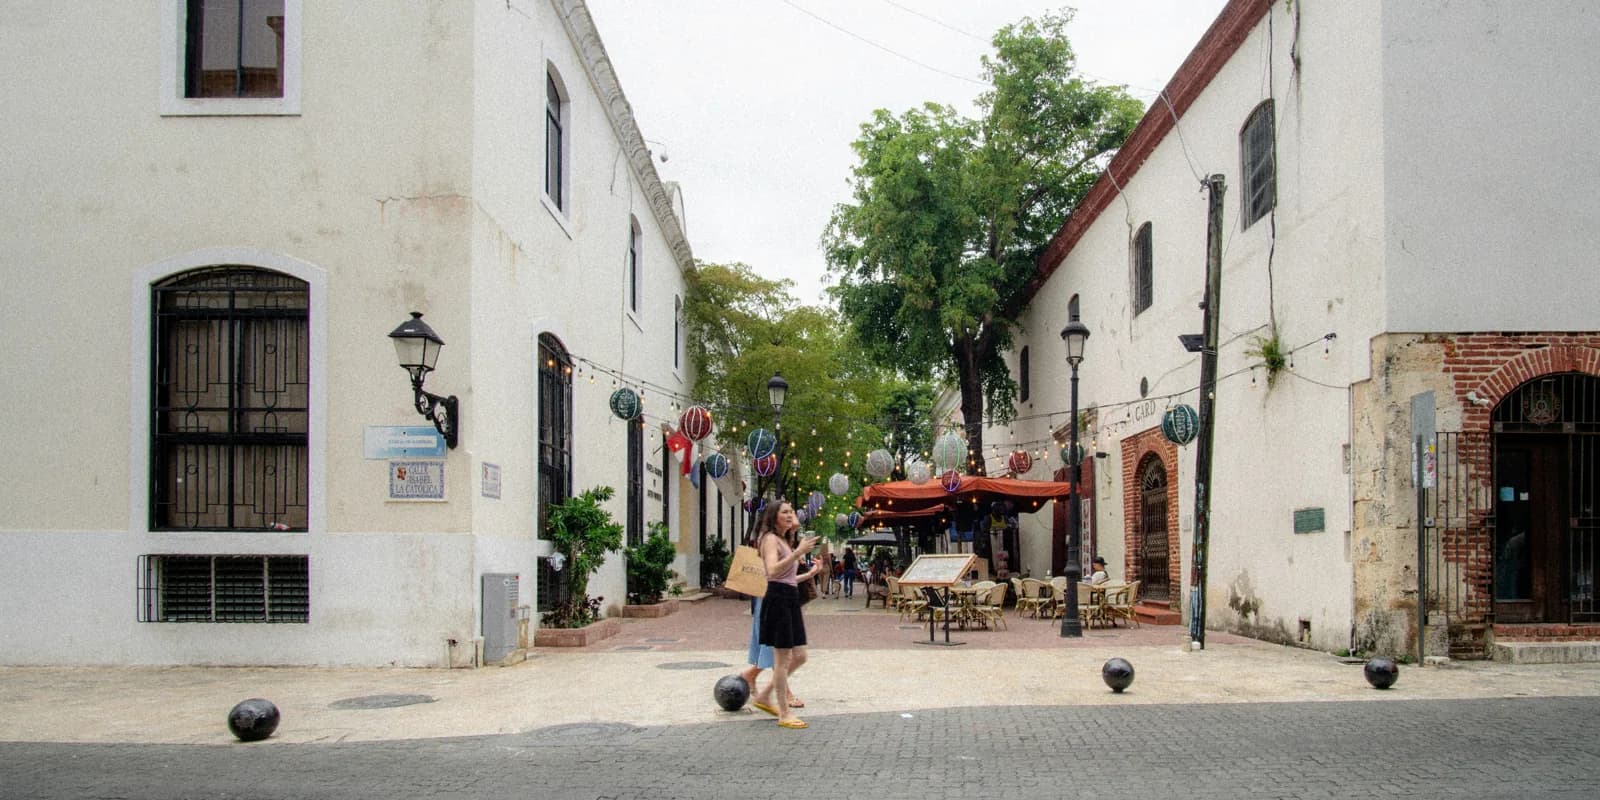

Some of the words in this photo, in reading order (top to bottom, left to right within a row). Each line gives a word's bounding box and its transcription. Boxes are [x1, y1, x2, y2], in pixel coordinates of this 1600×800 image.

[408, 464, 429, 475] CALLE
[408, 475, 432, 484] ISABEL
[395, 484, 405, 494] LA
